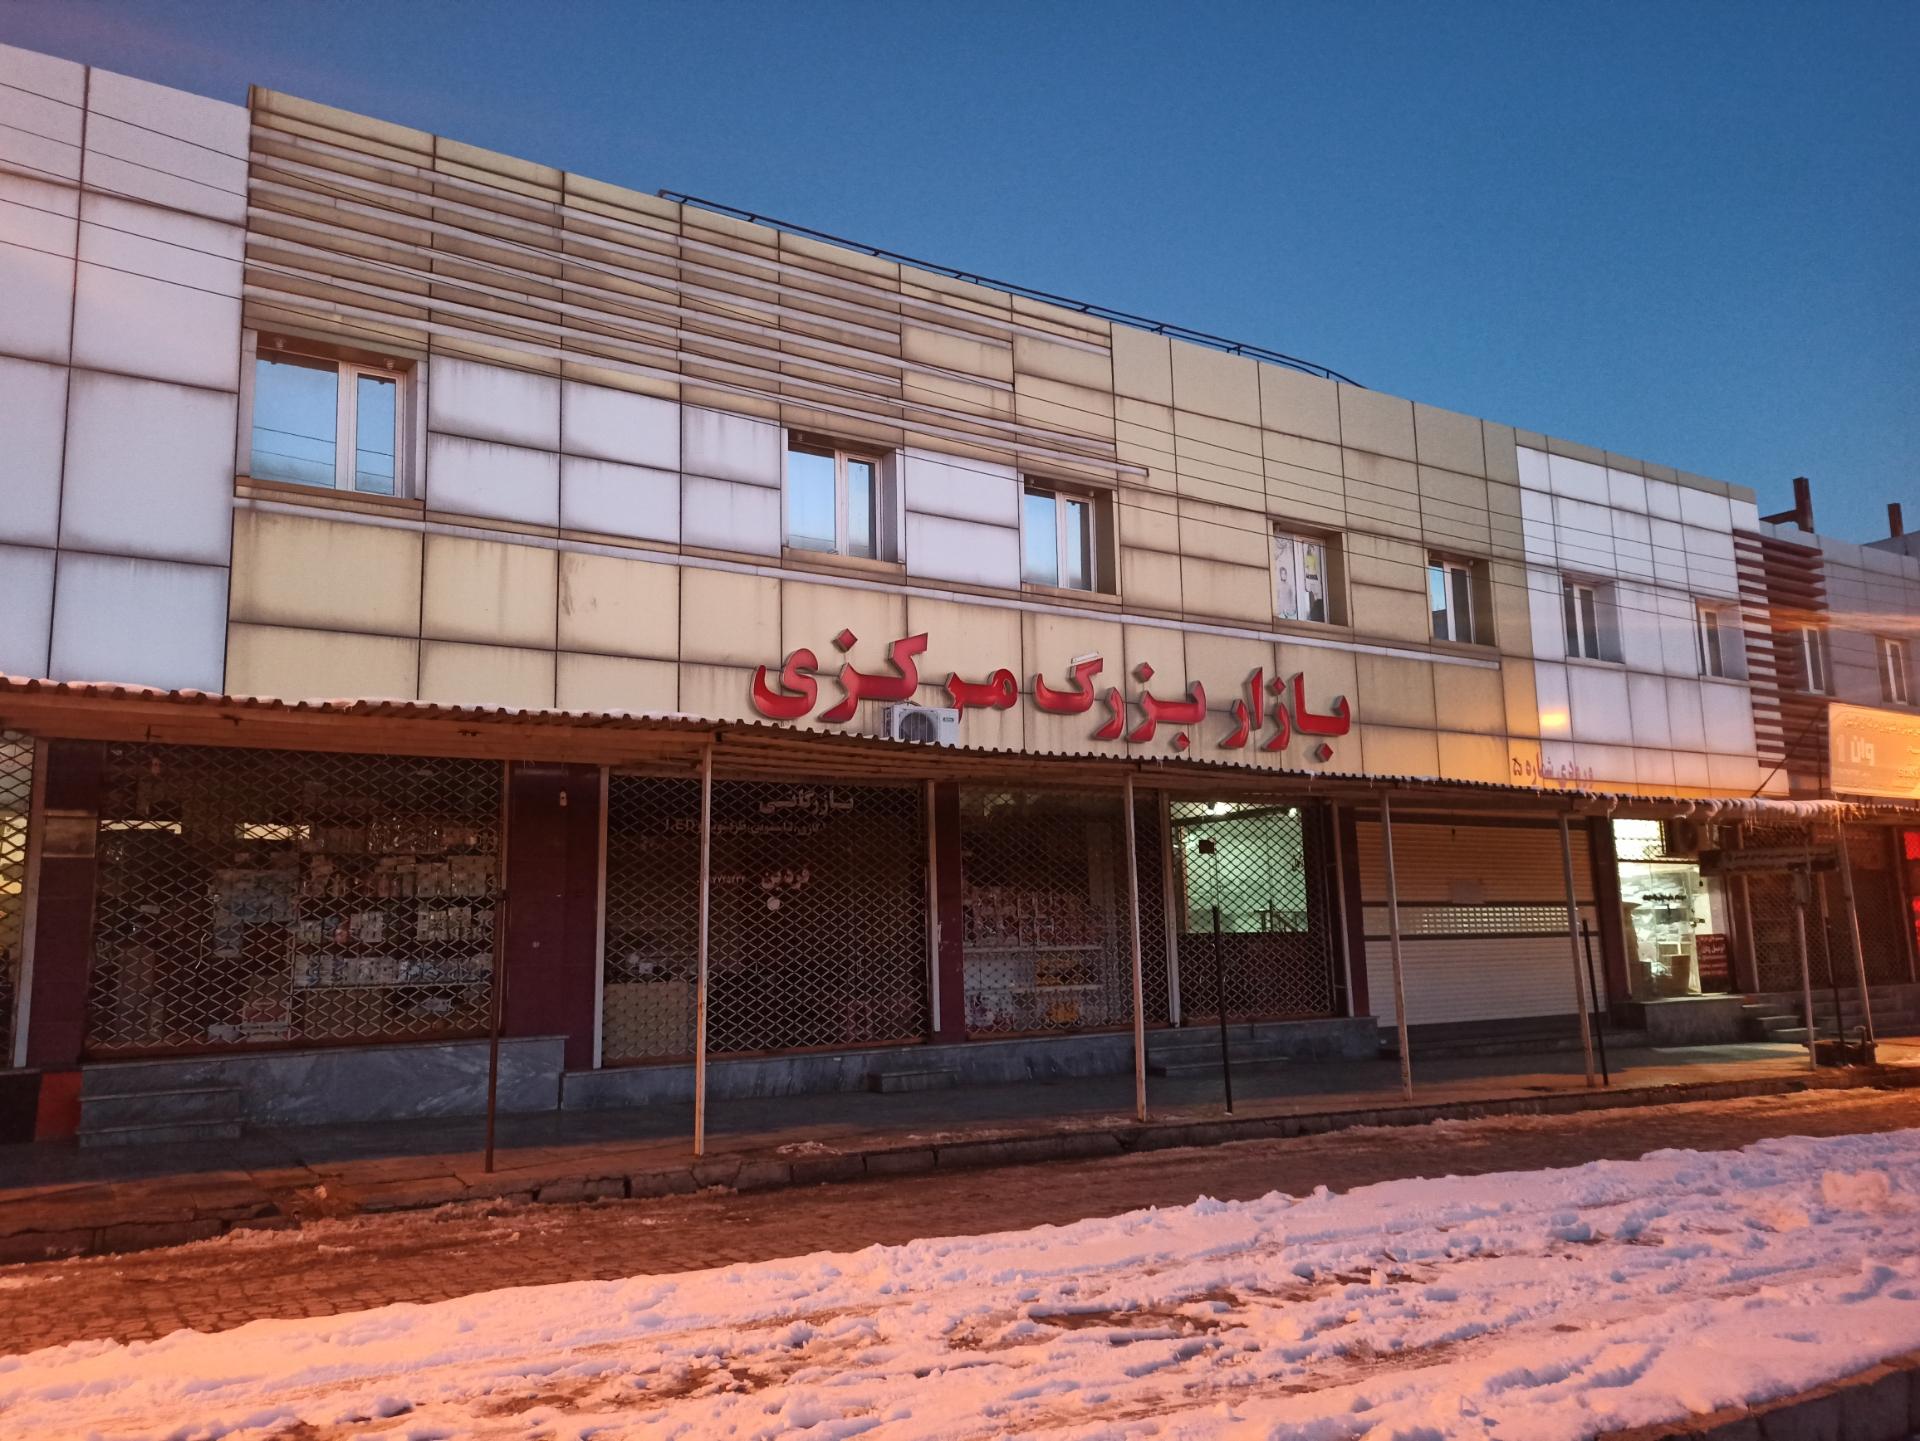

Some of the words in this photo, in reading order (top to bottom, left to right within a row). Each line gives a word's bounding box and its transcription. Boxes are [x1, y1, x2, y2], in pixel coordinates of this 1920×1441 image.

[750, 628, 1018, 724] مرکزی
[1033, 651, 1207, 752] بزرگ
[1218, 666, 1351, 762] بازار
